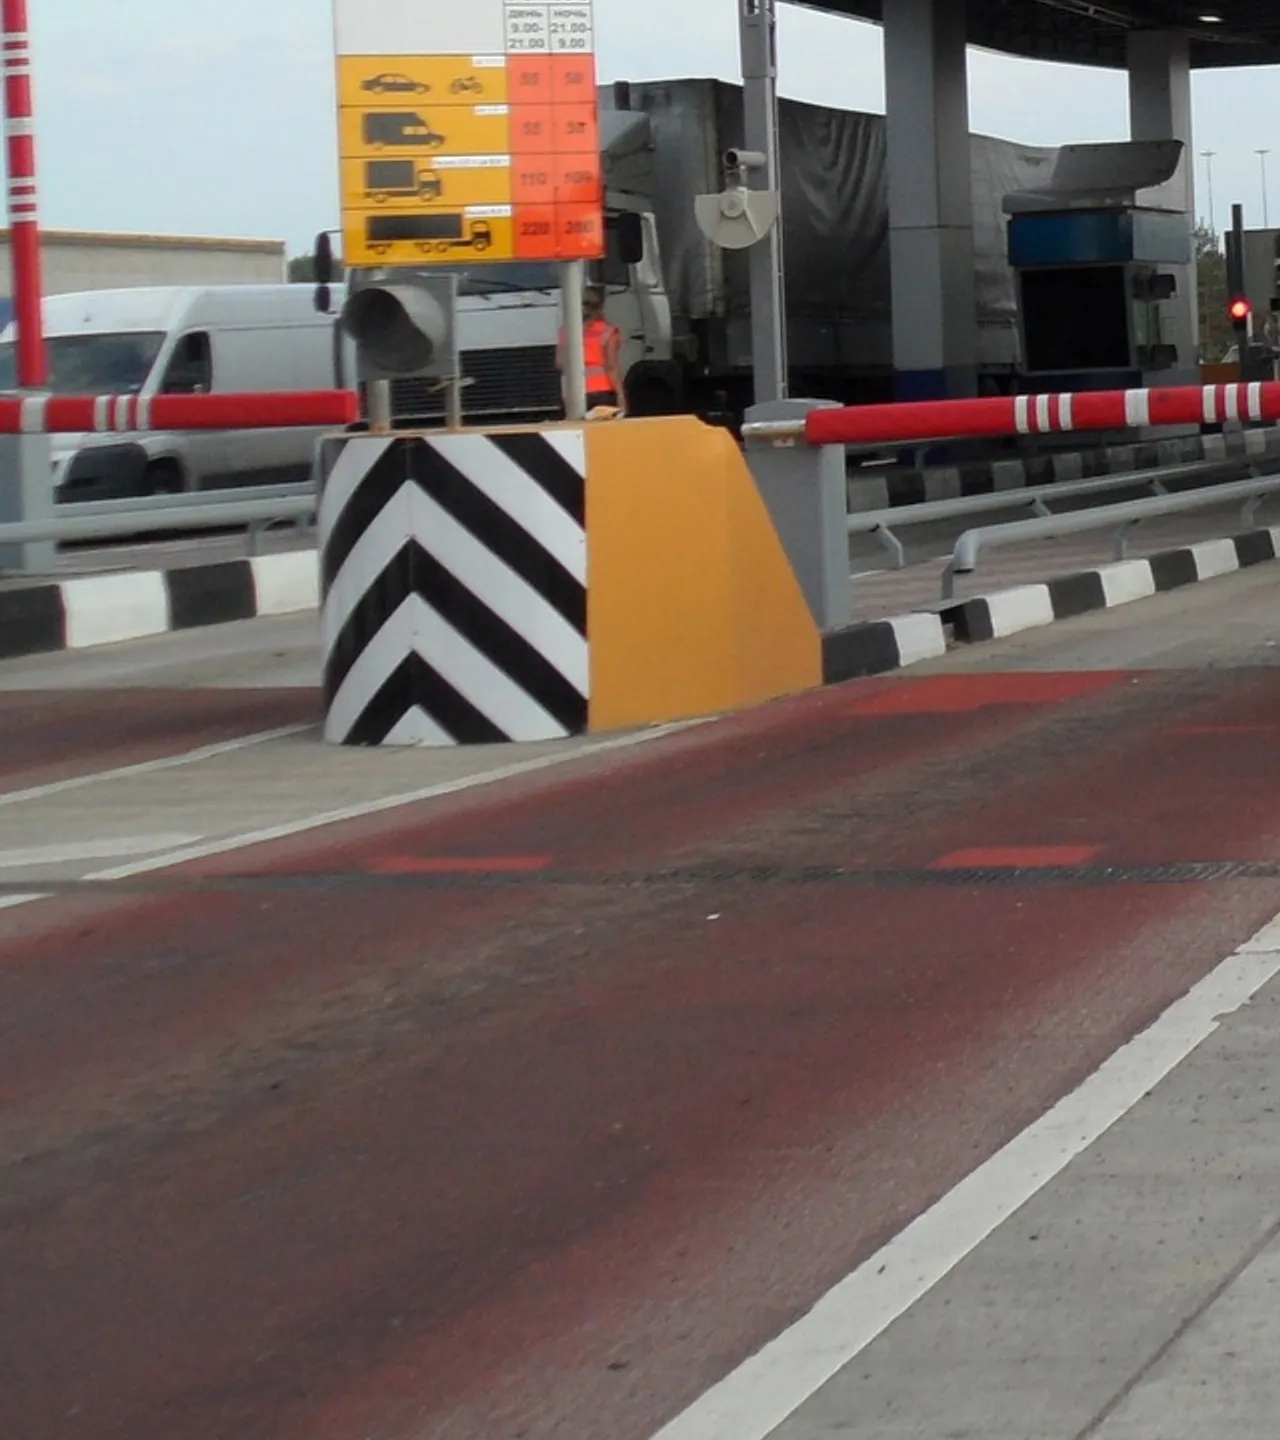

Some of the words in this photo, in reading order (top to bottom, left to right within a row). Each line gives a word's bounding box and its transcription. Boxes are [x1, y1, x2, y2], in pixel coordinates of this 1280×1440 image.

[510, 22, 544, 33] 9.00-
[550, 22, 592, 33] 21.00-
[508, 38, 545, 49] 21.00
[558, 38, 585, 49] 9.00
